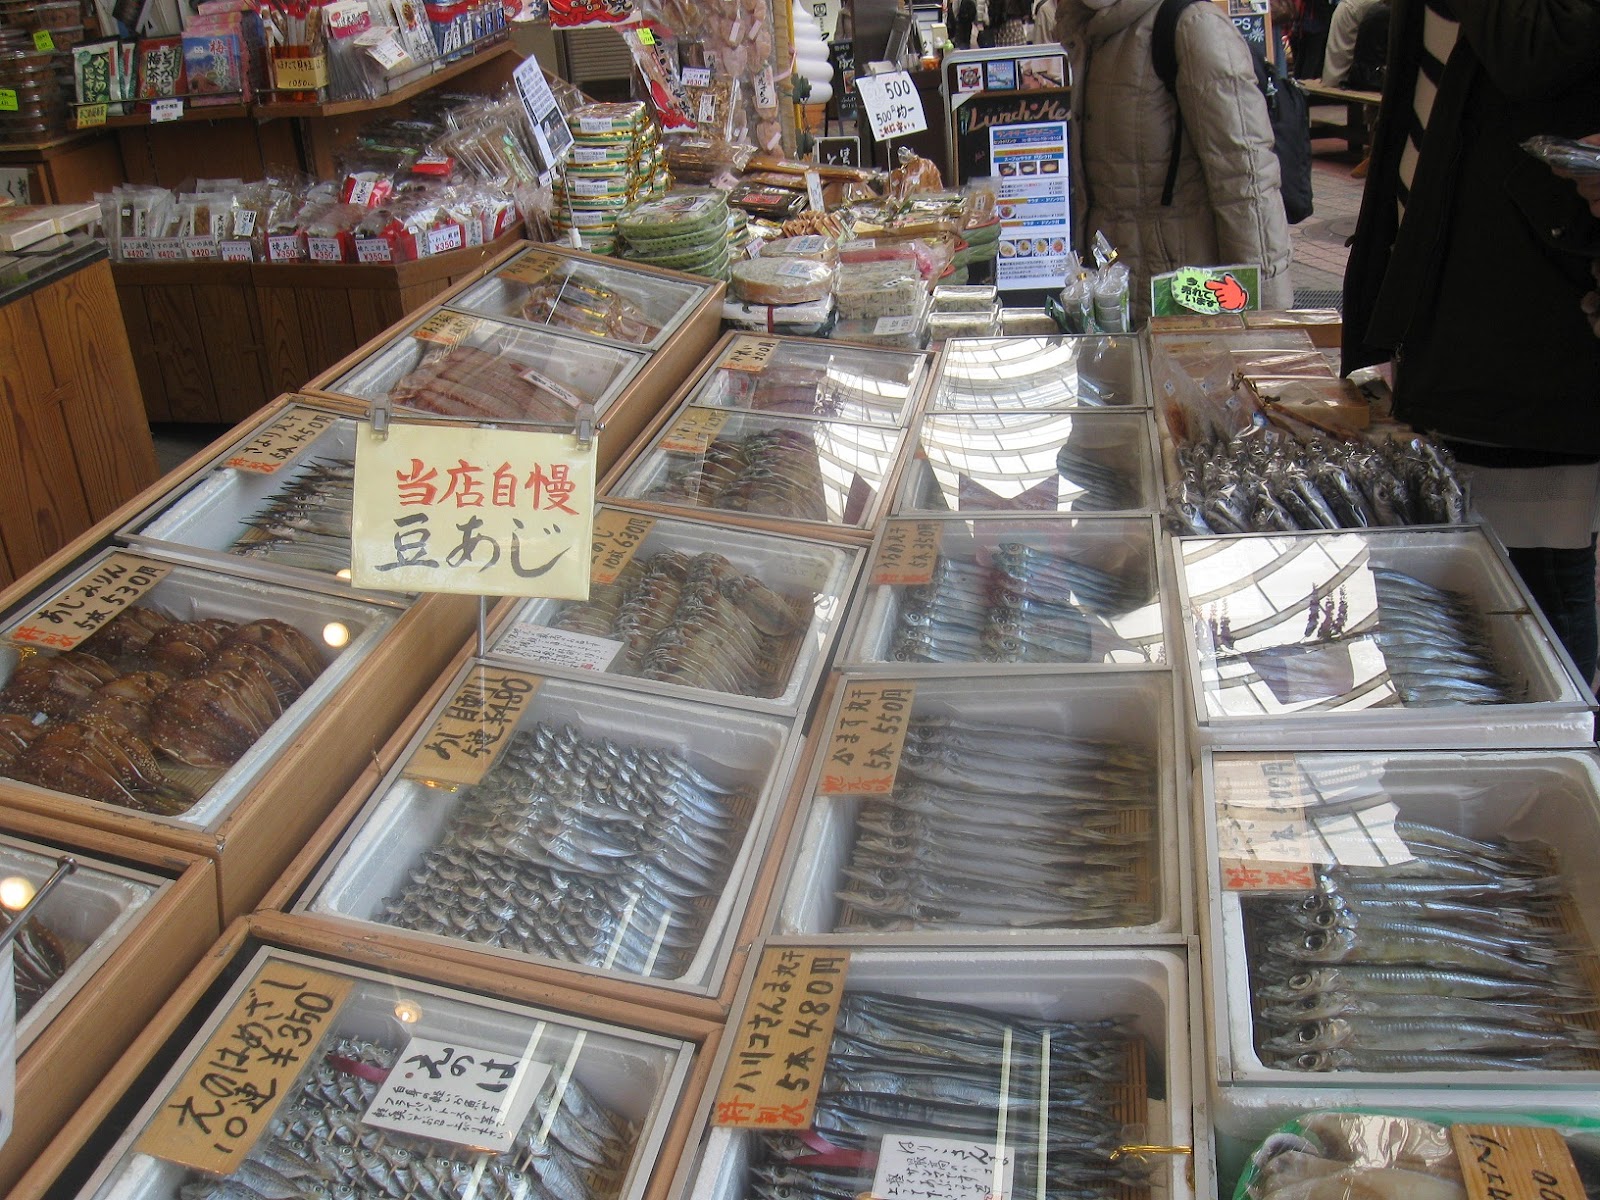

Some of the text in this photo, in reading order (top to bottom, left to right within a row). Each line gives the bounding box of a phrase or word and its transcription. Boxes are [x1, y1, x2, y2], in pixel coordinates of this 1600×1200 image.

[884, 79, 911, 100] 500
[127, 249, 145, 258] ¥420
[157, 250, 176, 258] ¥420
[191, 249, 210, 257] ¥420
[276, 249, 296, 258] ¥350
[314, 251, 334, 260] ¥350
[363, 252, 383, 260] ¥350
[434, 239, 455, 251] ¥350
[1181, 286, 1214, 300] 売れて
[1186, 295, 1217, 308] います
[287, 414, 336, 443] 450円
[395, 458, 580, 516] 当店自慢
[374, 512, 572, 579] 豆あじ
[36, 563, 129, 624] あじみりん
[100, 565, 166, 606] 530円
[831, 689, 878, 767] かます丸干
[870, 688, 913, 735] 550円
[257, 990, 334, 1068] ¥350
[733, 950, 805, 1093] ハリコさんま丸干
[775, 957, 846, 1093] 5本 480円
[167, 979, 308, 1135] えのはめざし
[403, 1047, 521, 1093] えのは
